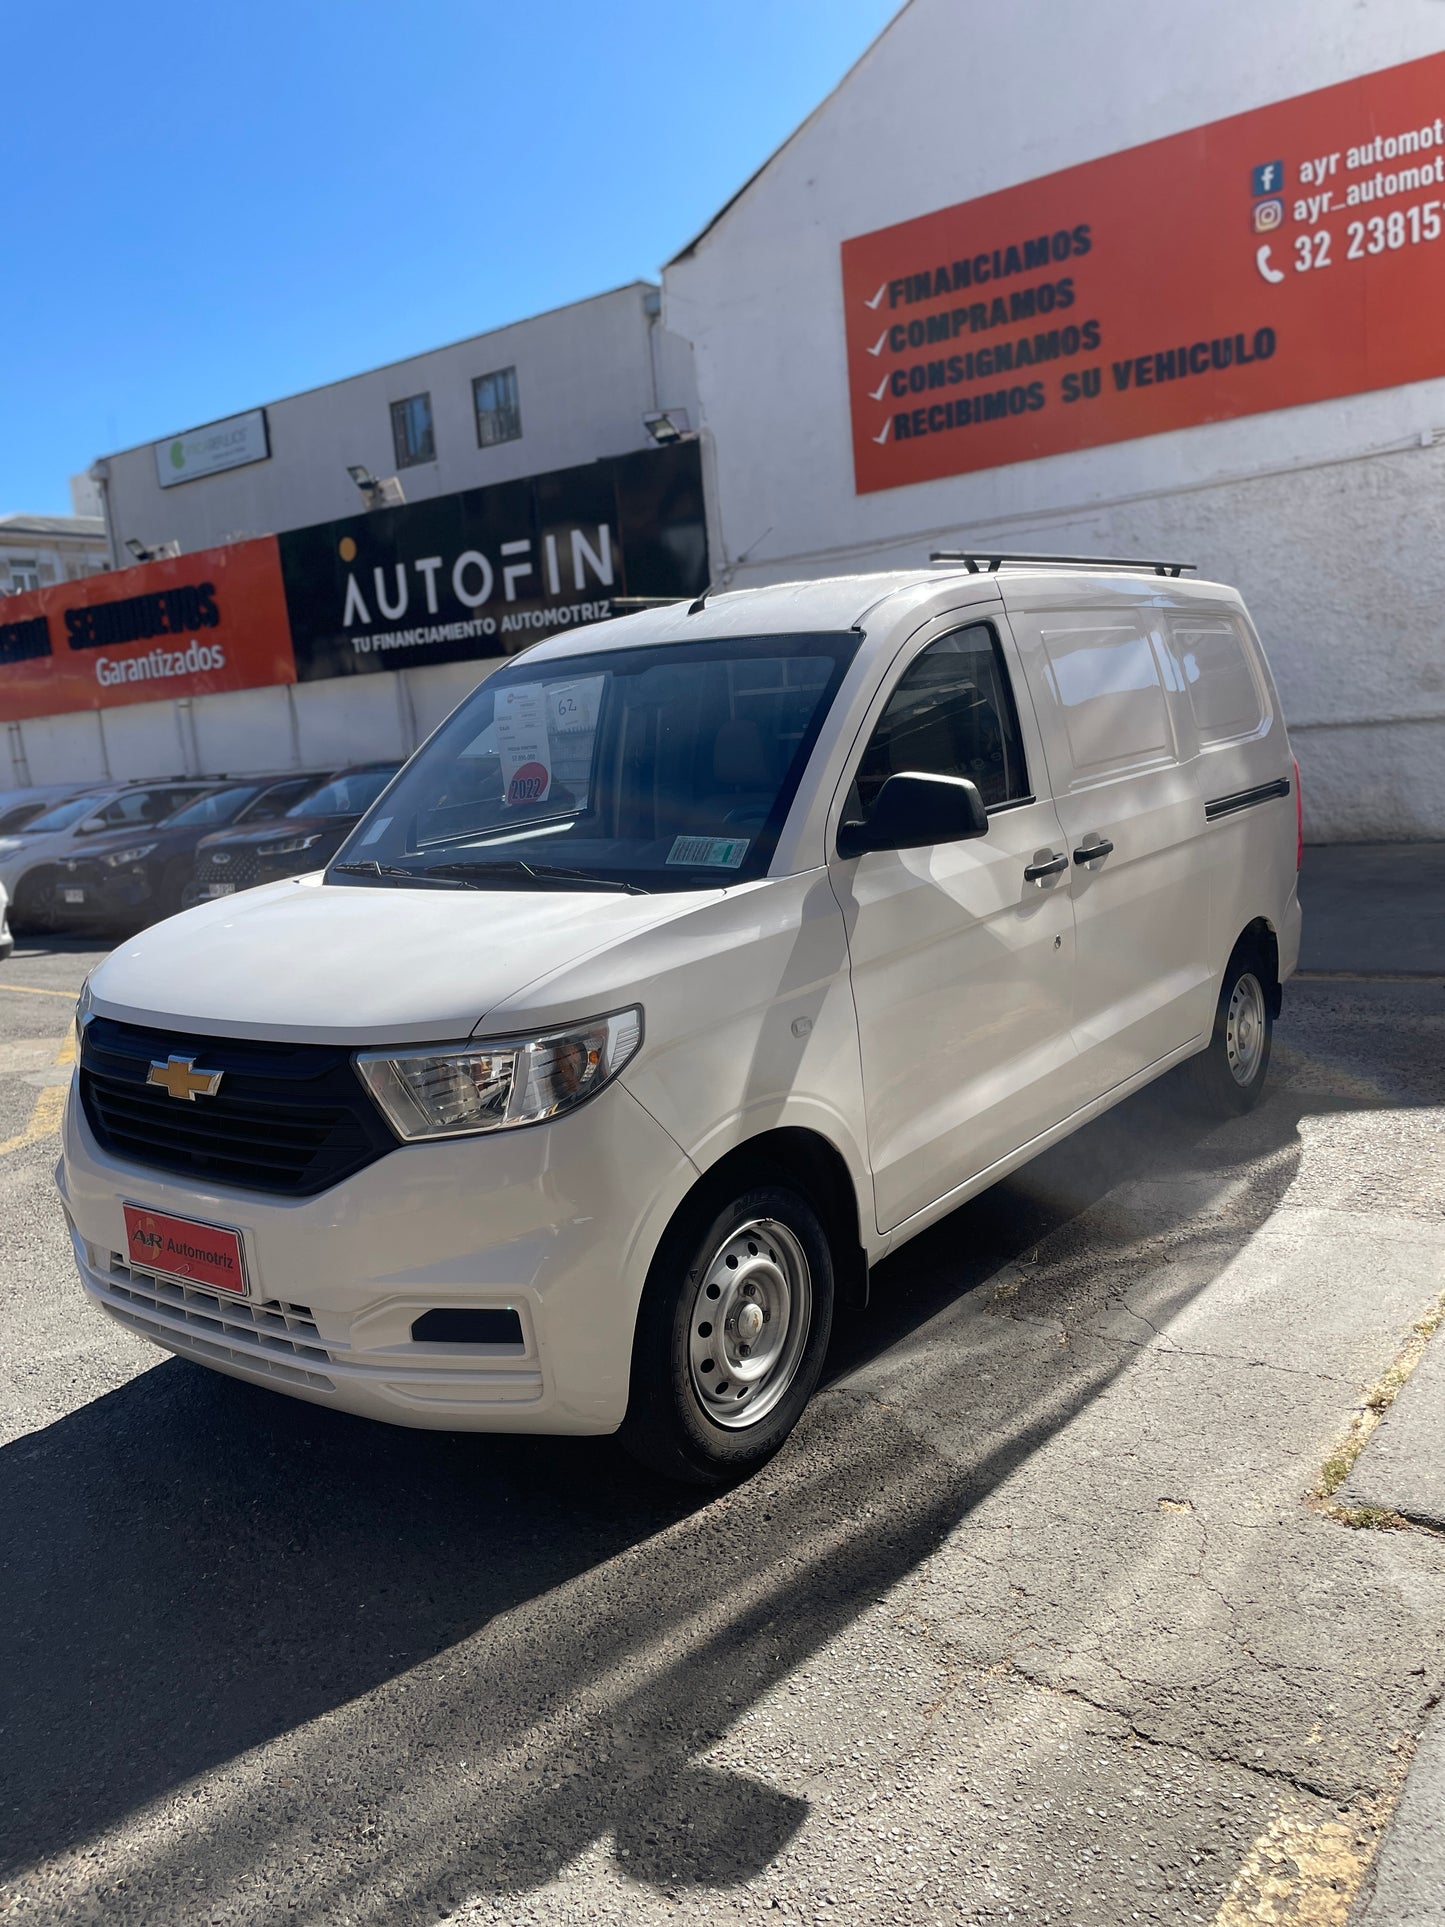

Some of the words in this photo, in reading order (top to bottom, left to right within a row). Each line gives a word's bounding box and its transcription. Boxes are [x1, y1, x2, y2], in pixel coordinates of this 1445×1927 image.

[1300, 152, 1340, 186] ayr
[888, 224, 1092, 309] FINANCIAMOS
[1295, 230, 1331, 272] 32
[1347, 200, 1445, 260] 23815
[889, 278, 1075, 353] COMPRAMOS
[891, 320, 1101, 398] CONSIGNAMOS
[894, 381, 1046, 441] RECIBIMOS
[1060, 367, 1102, 404] SU
[1112, 327, 1277, 392] VEHICULO
[343, 523, 614, 627] AUTOFIN
[352, 636, 371, 654] TU
[372, 617, 496, 652] FINANCIAMIENTO
[500, 600, 612, 633] AUTOMOTRIZ
[96, 639, 225, 686] Garantizados
[558, 698, 577, 716] 62
[511, 778, 541, 800] 2022
[167, 1239, 234, 1270] Automotriz
